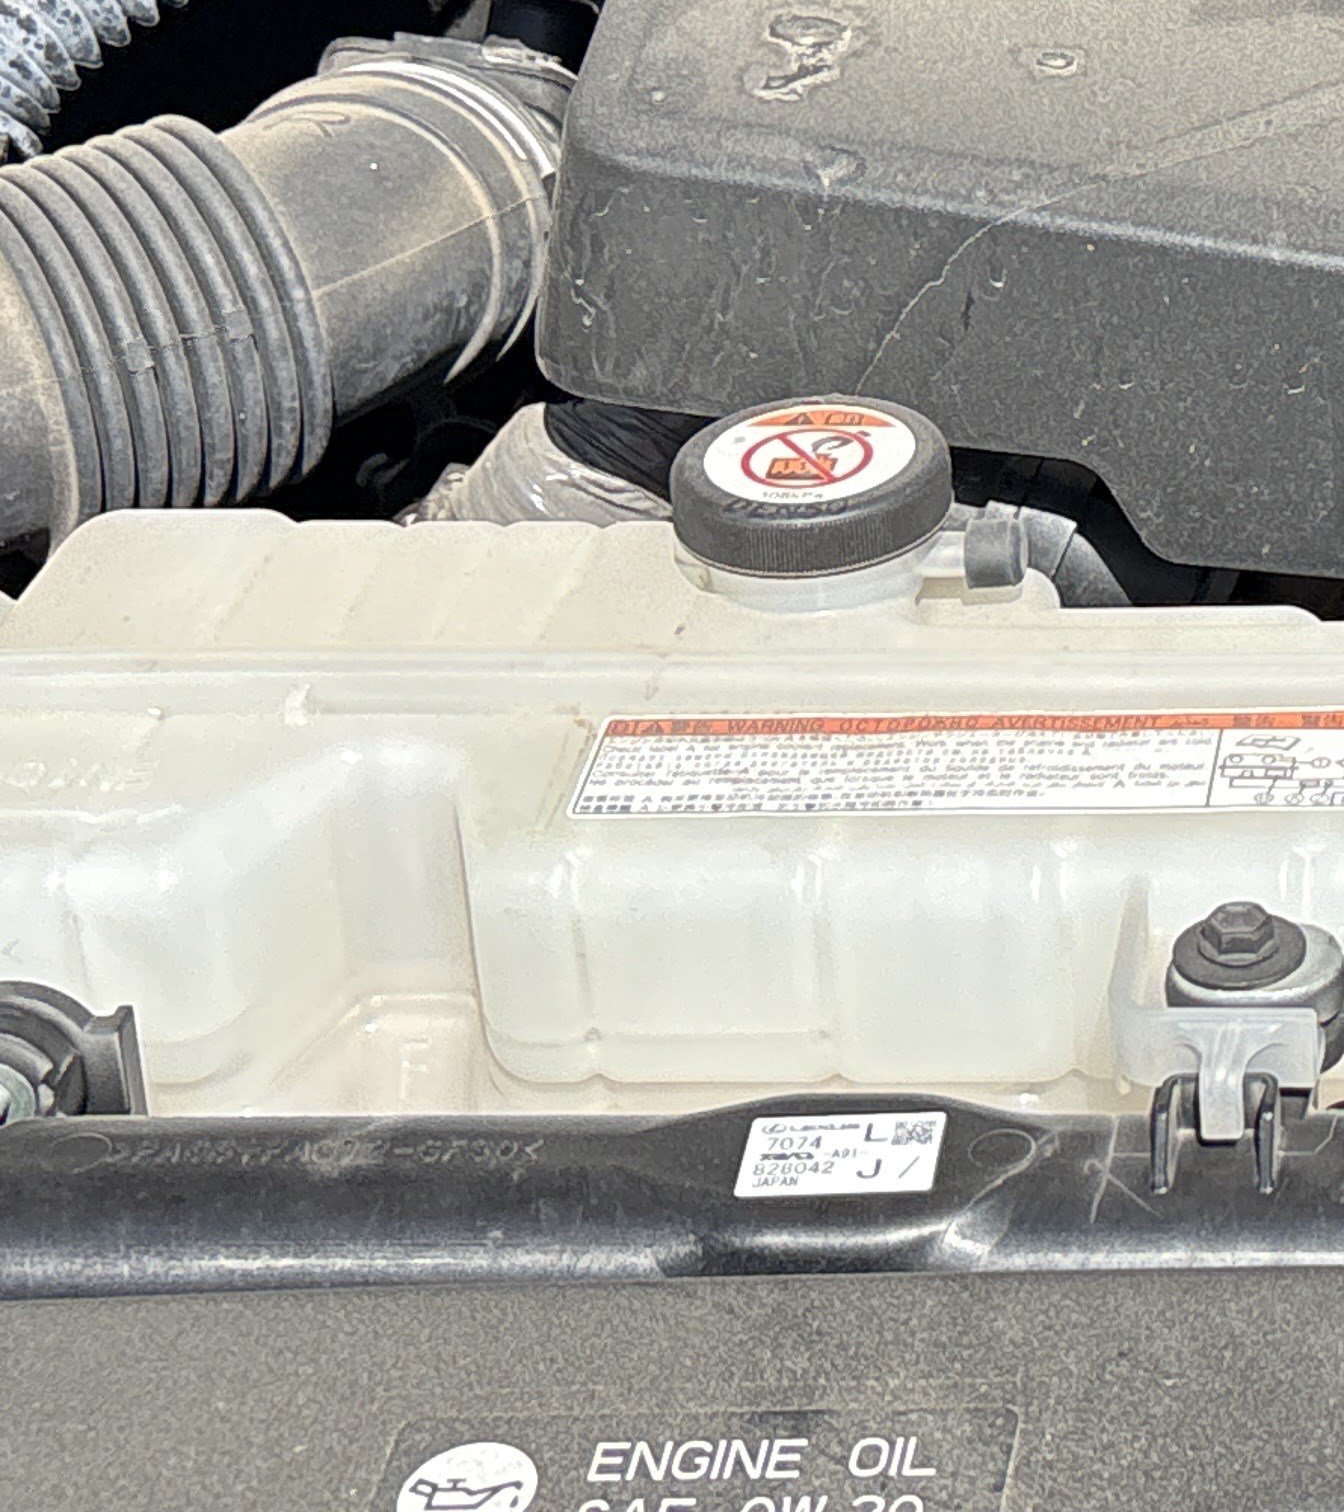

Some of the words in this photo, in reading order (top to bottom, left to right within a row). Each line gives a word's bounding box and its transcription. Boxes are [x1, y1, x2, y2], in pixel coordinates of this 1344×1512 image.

[727, 719, 824, 734] WARNING
[991, 715, 1163, 731] AVERTISSEMENT
[767, 1136, 822, 1151] 7074
[856, 1158, 882, 1179] J
[752, 1175, 799, 1188] JAPAN
[586, 1437, 809, 1482] ENGINE
[847, 1435, 937, 1478] OIL
